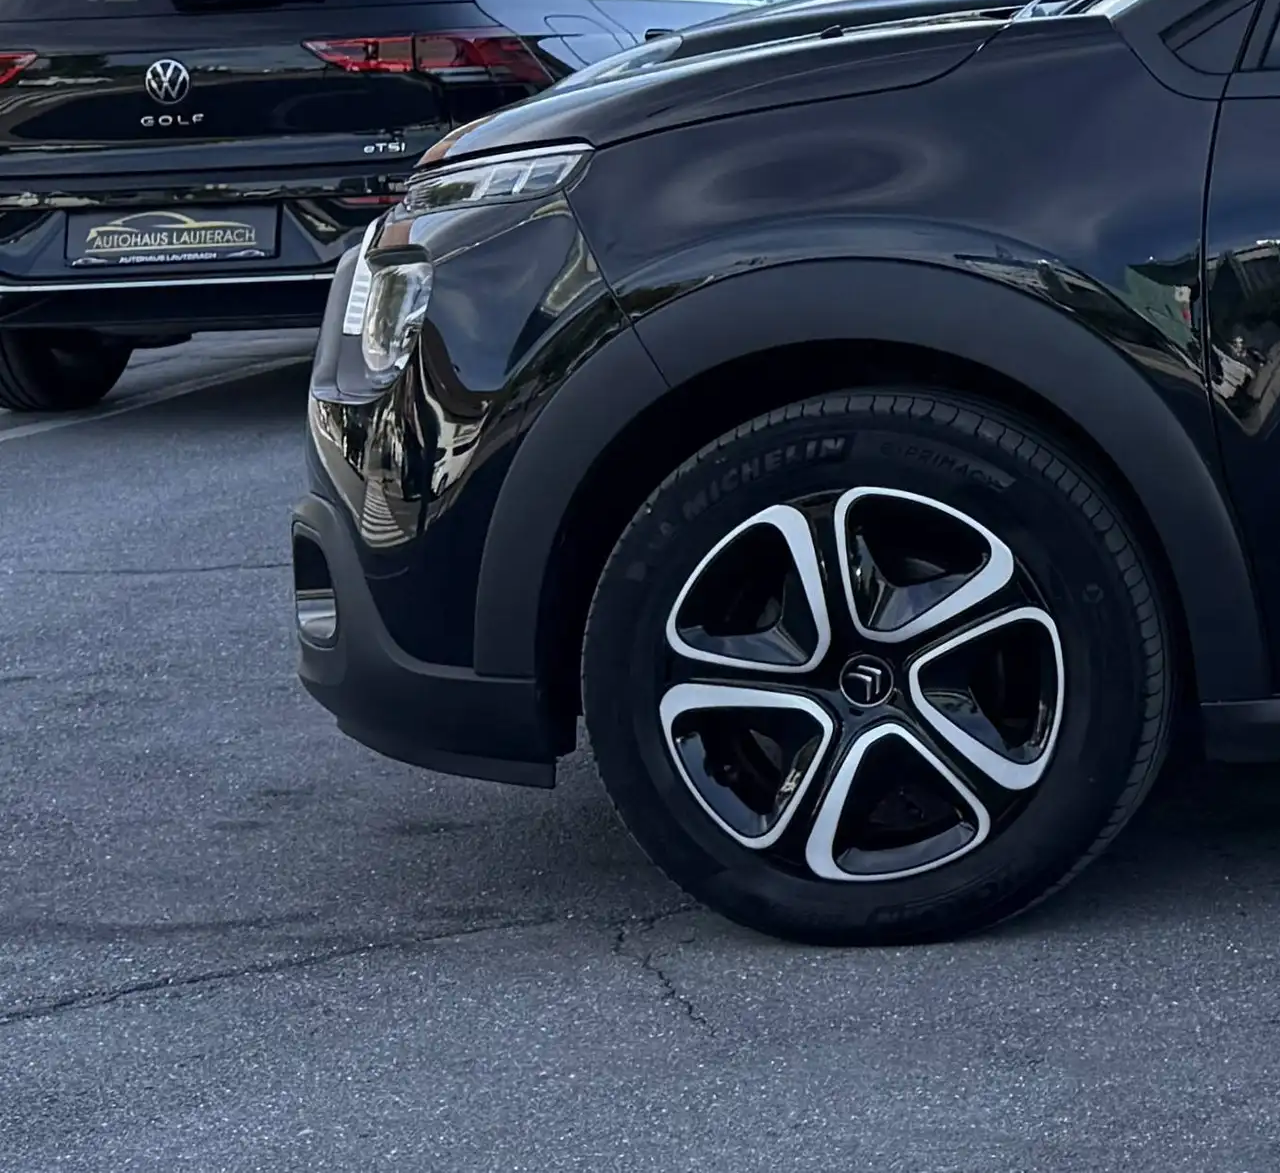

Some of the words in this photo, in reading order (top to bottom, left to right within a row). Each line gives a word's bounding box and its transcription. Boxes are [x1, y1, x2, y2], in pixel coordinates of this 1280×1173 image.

[140, 113, 204, 127] GOLF
[363, 142, 406, 154] eTSI
[93, 231, 168, 249] AUTOHAUS
[172, 228, 256, 244] LAUTERACH
[682, 436, 847, 521] MICHELIN
